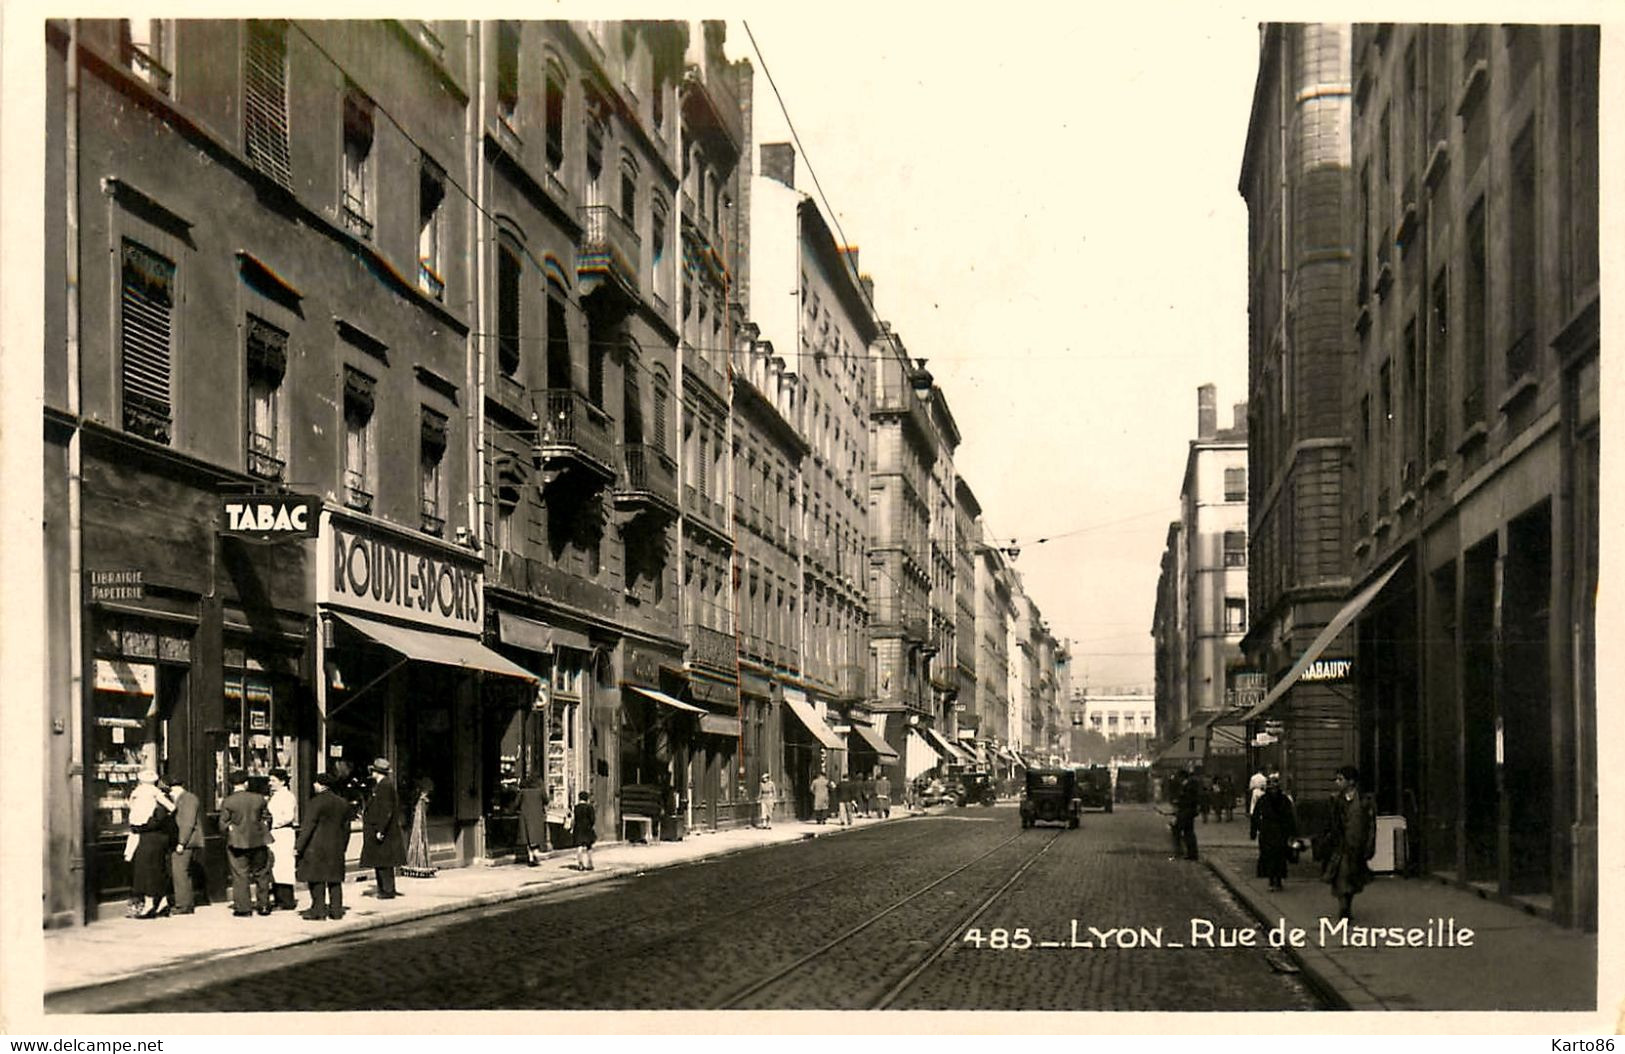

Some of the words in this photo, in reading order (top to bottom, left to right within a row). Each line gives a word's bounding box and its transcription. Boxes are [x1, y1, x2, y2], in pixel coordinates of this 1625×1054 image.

[226, 504, 307, 530] TABAC
[91, 571, 142, 585] LIBRAIRIE
[334, 530, 479, 623] ROUDIL-SPORTS
[91, 586, 142, 600] PAPETERIE
